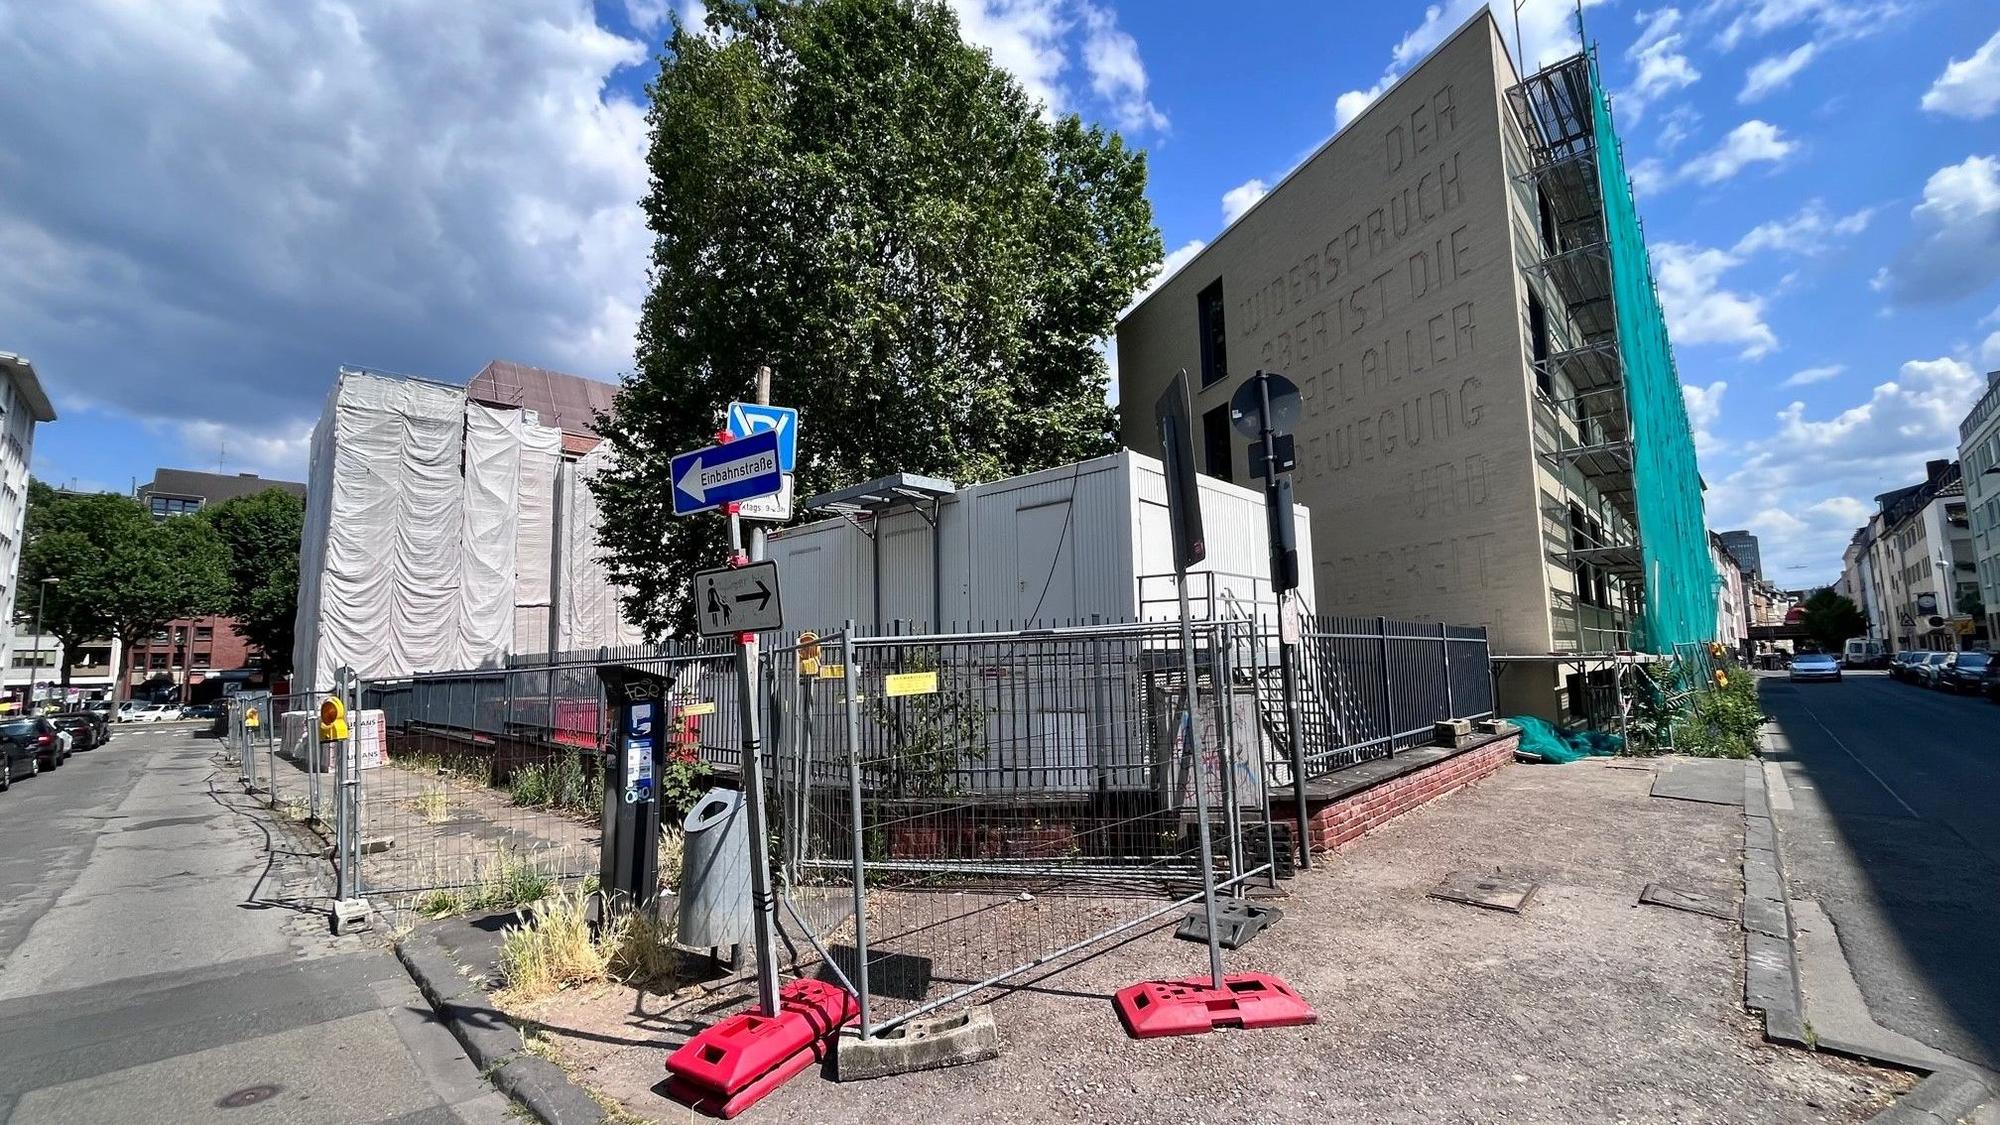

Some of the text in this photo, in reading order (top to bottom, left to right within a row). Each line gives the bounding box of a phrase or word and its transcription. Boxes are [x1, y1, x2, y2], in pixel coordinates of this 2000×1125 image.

[1385, 84, 1456, 177] DER
[1338, 267, 1394, 342] IST
[1409, 224, 1472, 303] DIE
[1362, 301, 1477, 396] ALLER
[701, 457, 773, 486] Einbahnstraße
